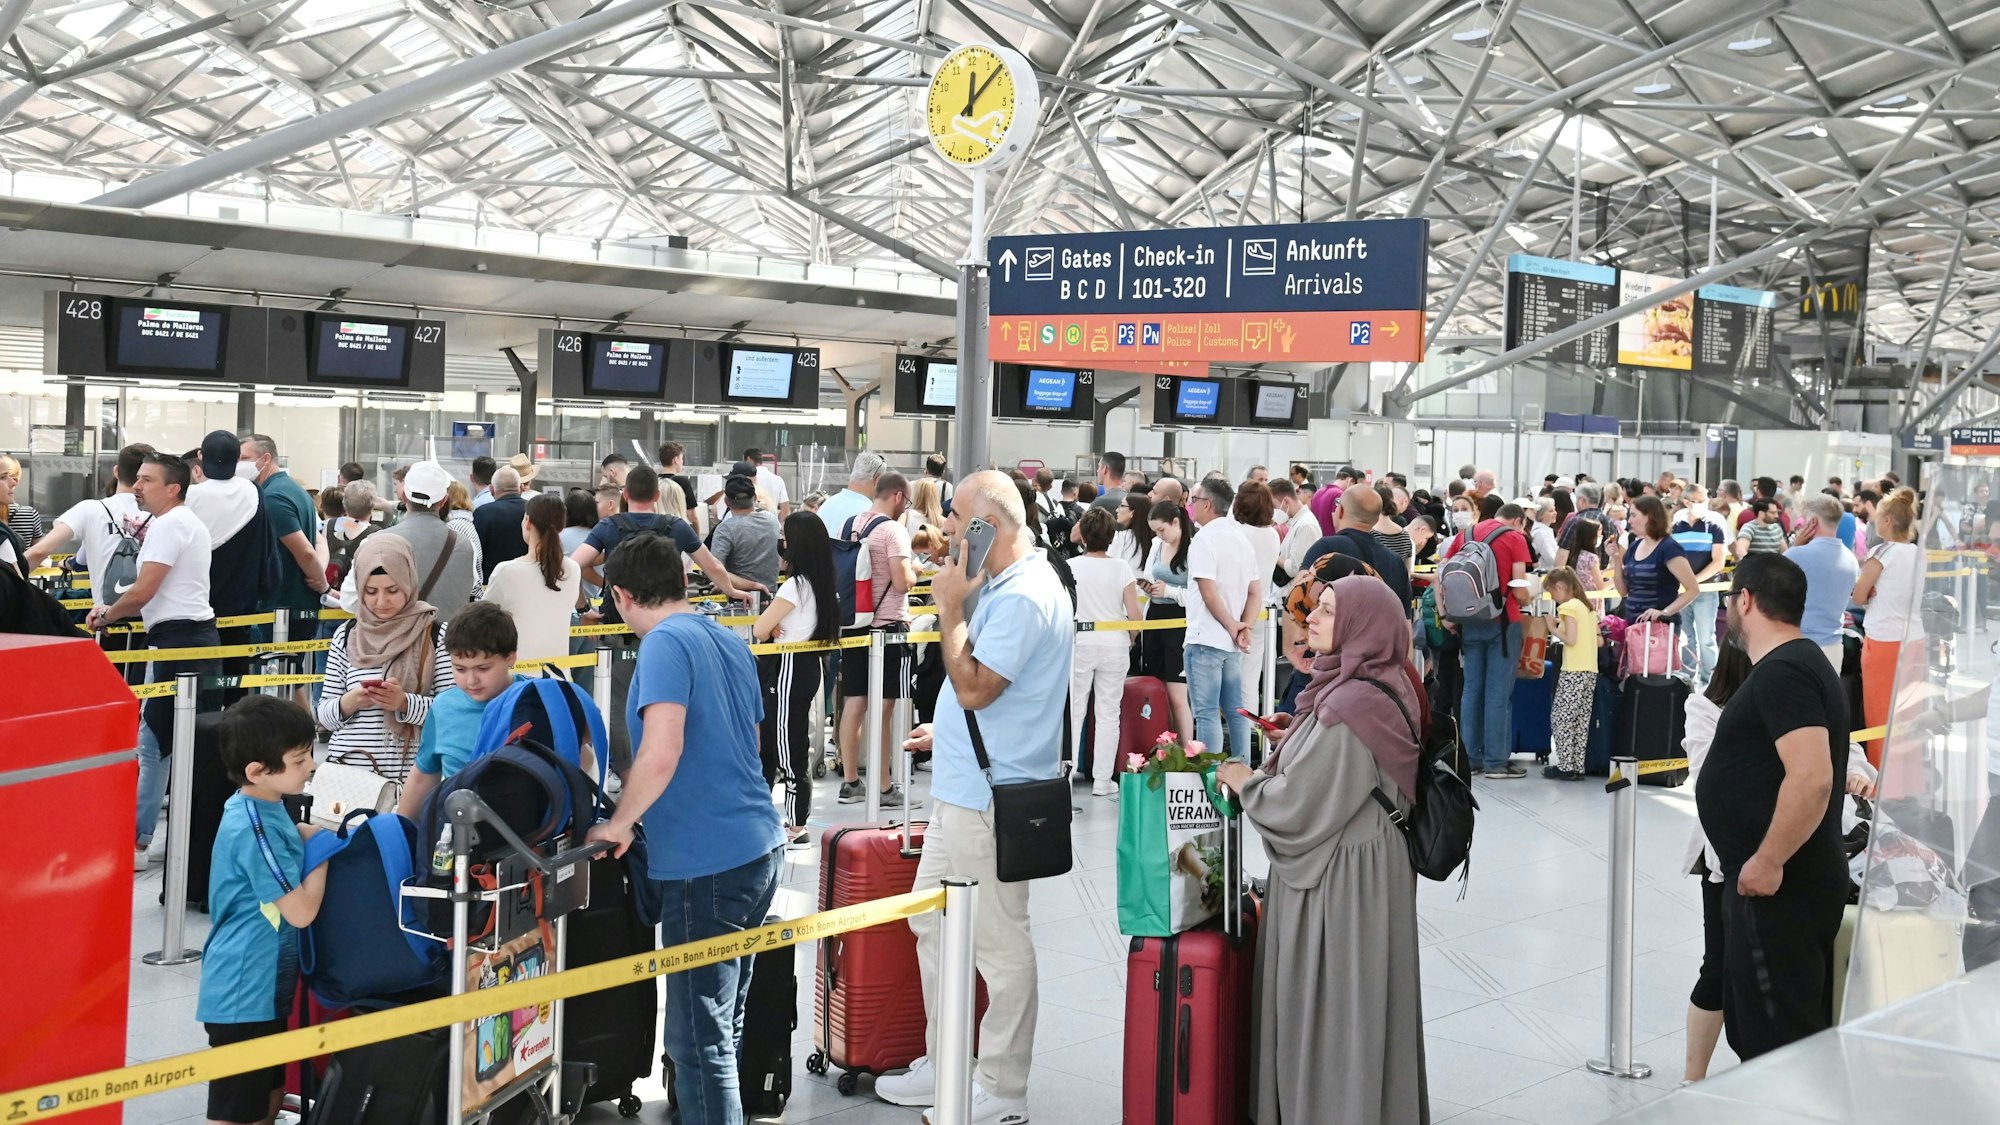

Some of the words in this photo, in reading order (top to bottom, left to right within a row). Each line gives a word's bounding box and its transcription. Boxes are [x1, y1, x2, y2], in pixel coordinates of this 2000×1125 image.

[968, 56, 976, 66] 12
[986, 62, 990, 70] 1
[952, 66, 960, 75] 11
[998, 76, 1002, 86] 2
[940, 83, 948, 92] 10
[1002, 97, 1006, 106] 3
[936, 105, 940, 114] 9
[941, 126, 946, 134] 8
[952, 142, 956, 151] 7
[986, 138, 990, 148] 5
[968, 146, 973, 154] 6
[1286, 237, 1368, 261] Ankunft
[1062, 248, 1112, 268] Gates
[1134, 244, 1214, 267] Check-in
[1061, 280, 1070, 300] B
[1078, 280, 1088, 300] C
[1096, 279, 1106, 299] D
[1132, 276, 1206, 299] 101-320
[1285, 272, 1363, 296] Arrivals
[66, 300, 102, 320] 428
[138, 320, 160, 329] Palma
[162, 322, 171, 330] de
[172, 322, 204, 331] Mallorca
[1168, 324, 1196, 334] Polizei
[1204, 324, 1220, 333] Zoll
[335, 333, 354, 341] Palma
[364, 335, 392, 344] Mallorca
[414, 326, 441, 344] 427
[1041, 326, 1054, 344] S
[1070, 328, 1077, 340] H
[558, 336, 582, 352] 426
[1167, 336, 1192, 346] Police
[1204, 336, 1238, 346] Customs
[797, 352, 817, 368] 425
[898, 359, 916, 374] 424
[1156, 377, 1171, 390] 422
[1168, 789, 1194, 804] ICH
[797, 925, 814, 936] Köln
[816, 920, 836, 932] Bonn
[838, 913, 867, 930] Airport
[660, 957, 680, 968] Köln
[684, 952, 704, 964] Bonn
[708, 942, 740, 958] Airport
[528, 1036, 550, 1057] corendon
[67, 1088, 99, 1104] Köln
[105, 1080, 138, 1096] Bonn
[144, 1065, 196, 1088] Airport
